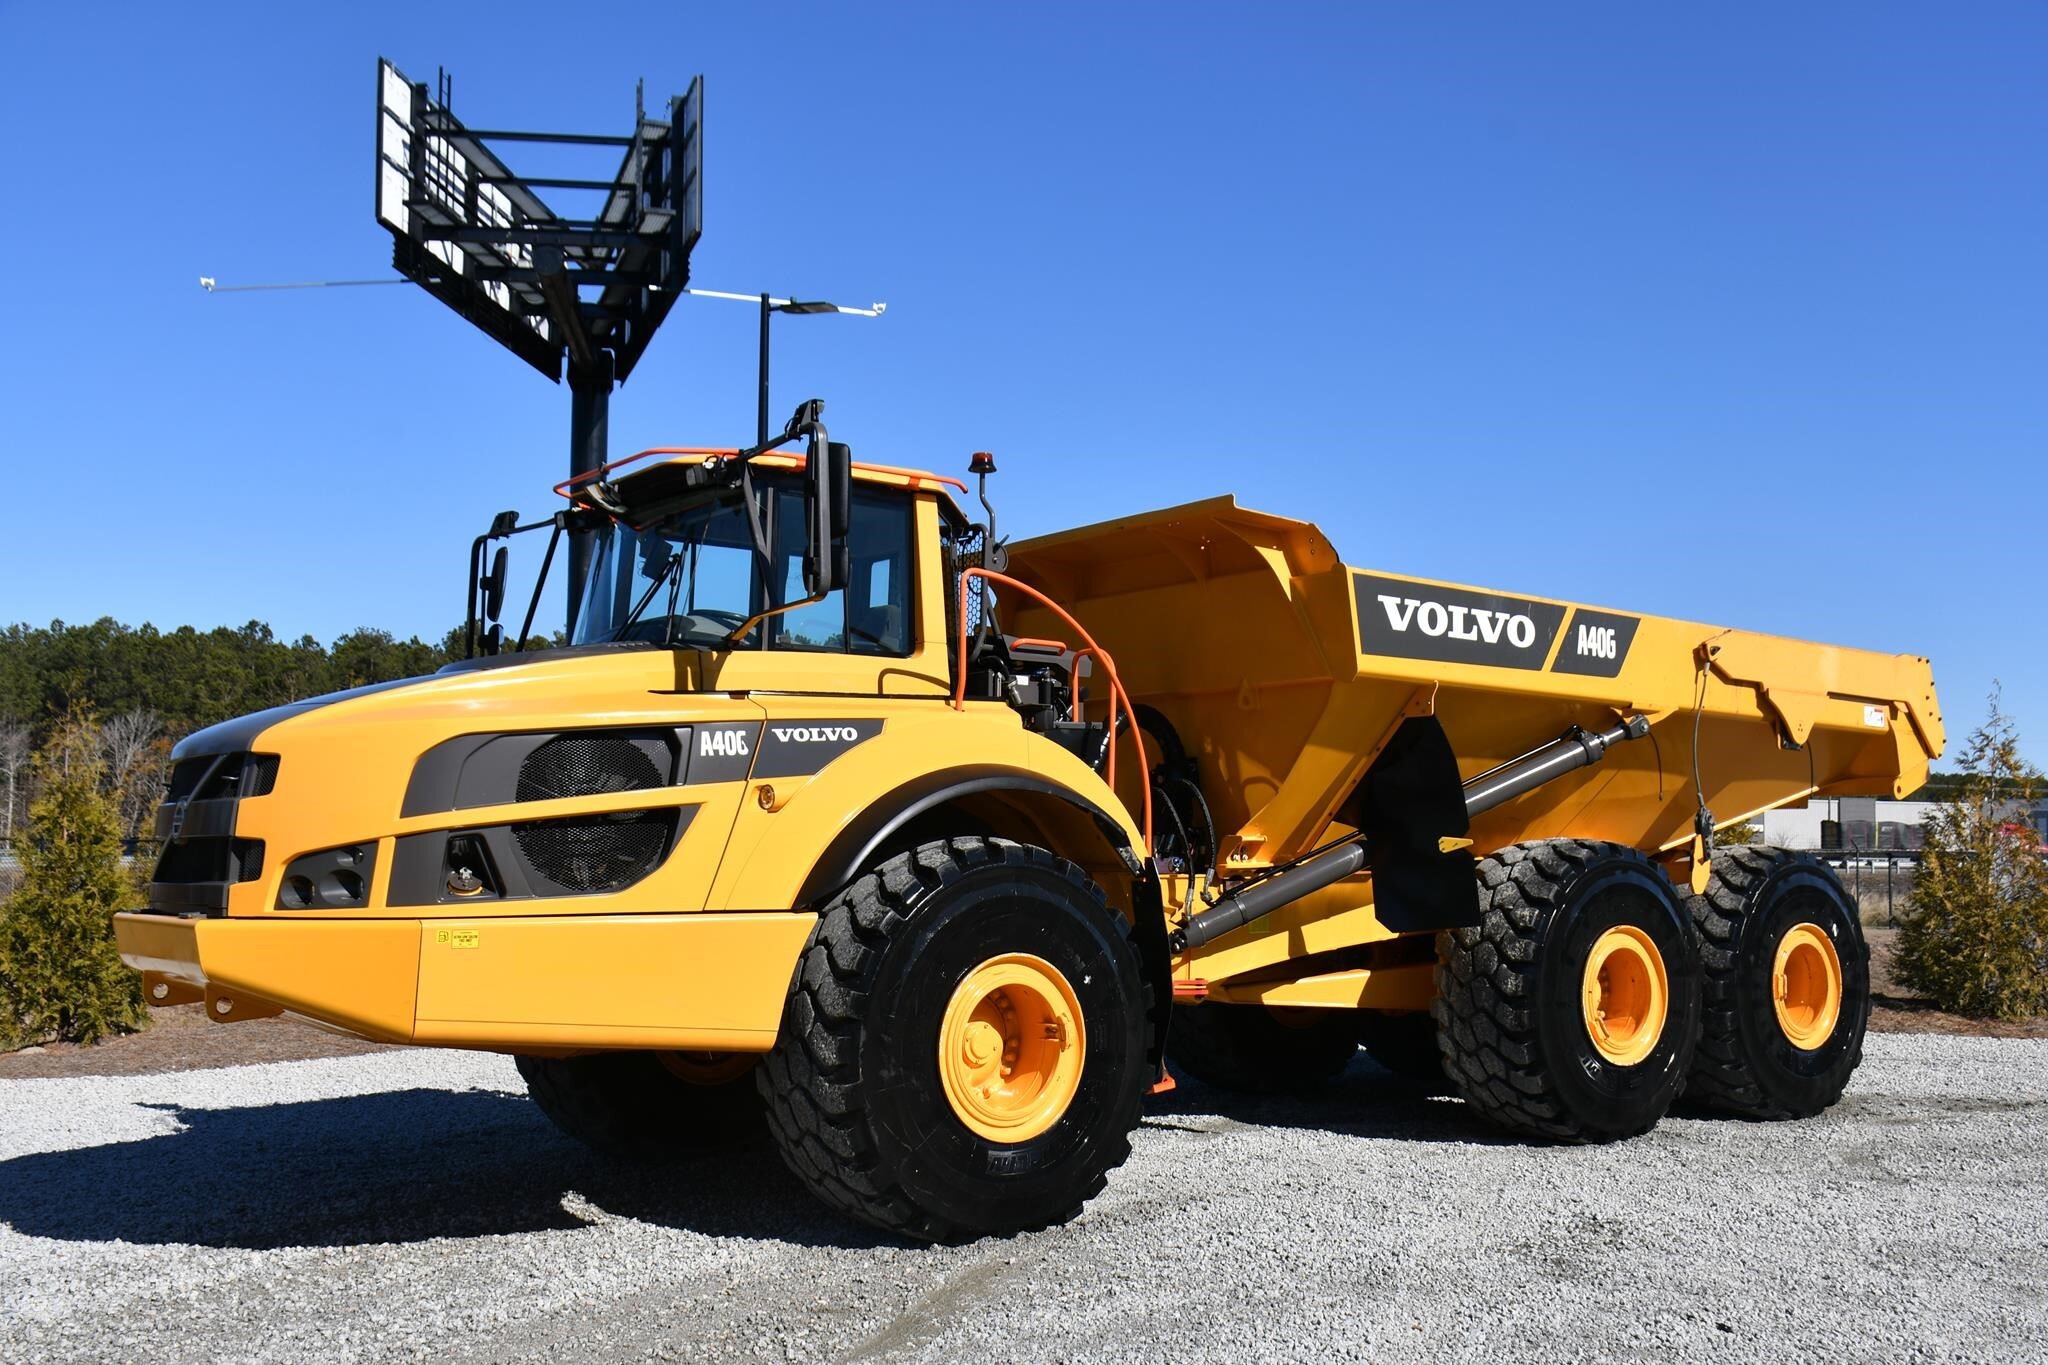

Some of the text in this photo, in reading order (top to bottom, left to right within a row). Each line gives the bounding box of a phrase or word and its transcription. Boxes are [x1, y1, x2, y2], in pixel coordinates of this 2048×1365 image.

[1377, 594, 1617, 660] VOLVO A40G
[700, 729, 749, 757] A40G
[771, 726, 858, 743] VOLVO
